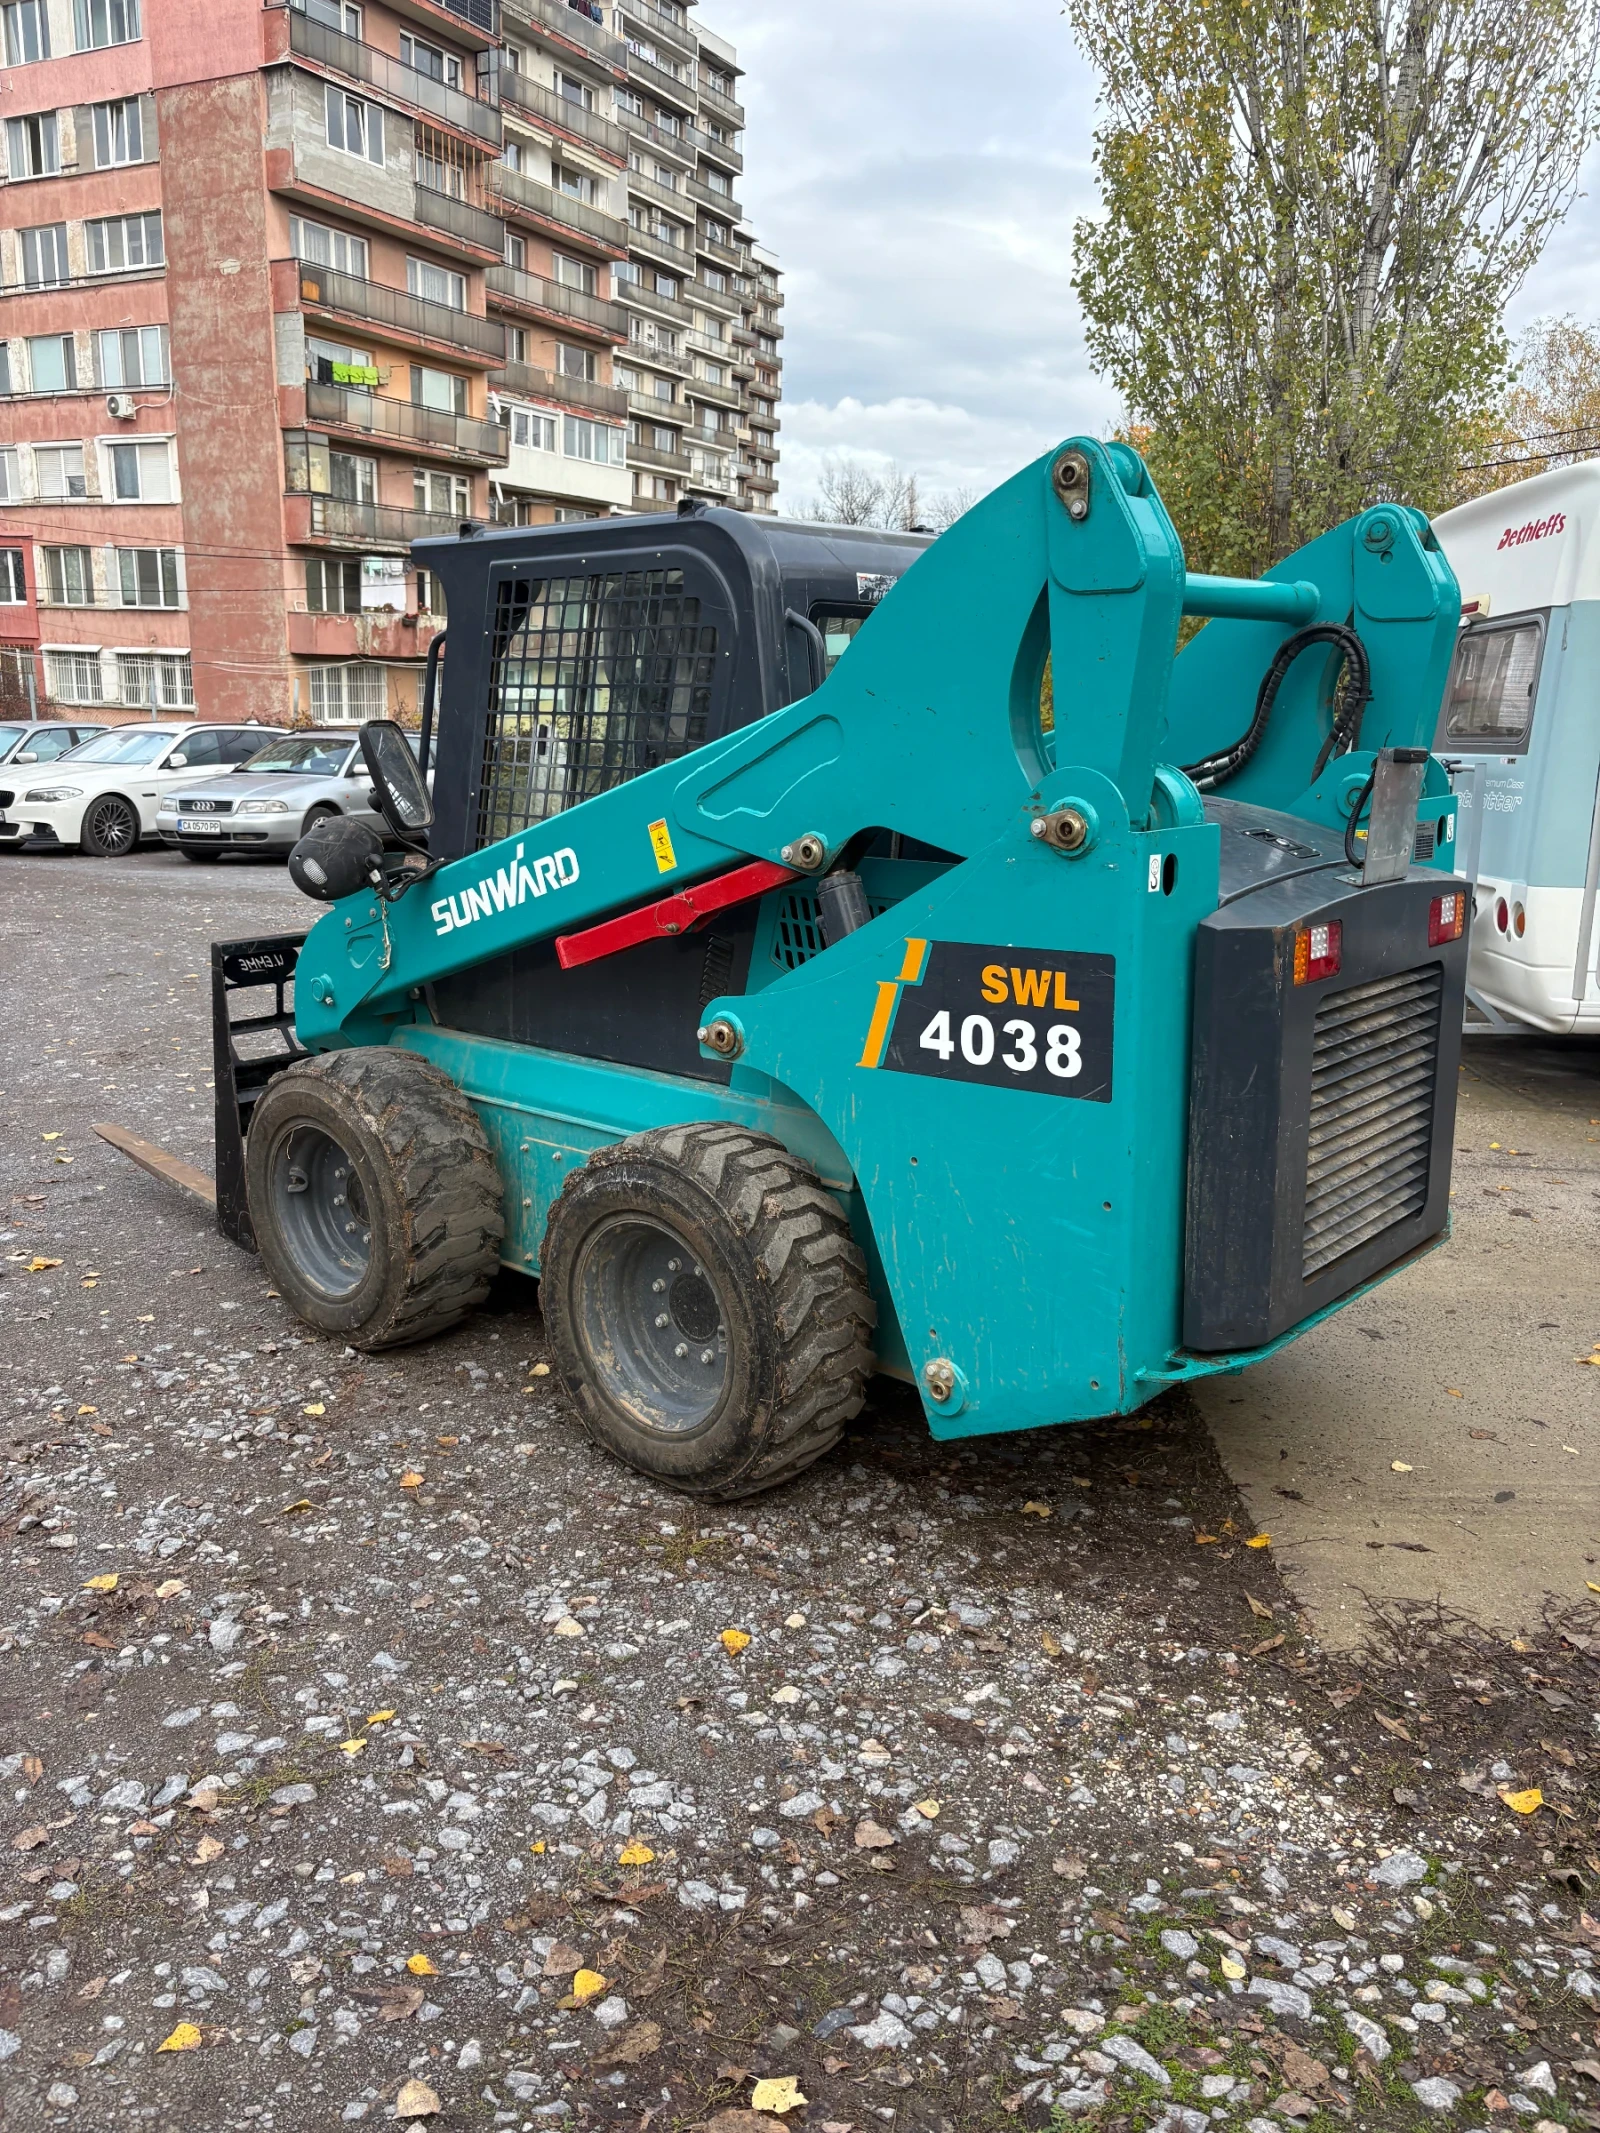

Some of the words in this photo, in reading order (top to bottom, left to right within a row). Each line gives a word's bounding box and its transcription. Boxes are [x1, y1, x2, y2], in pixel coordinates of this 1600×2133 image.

[1497, 513, 1566, 550] Dethleffs
[183, 821, 191, 830] CA
[193, 822, 208, 831] 0570
[210, 822, 219, 831] PP
[431, 842, 580, 936] SUNWARD
[981, 964, 1080, 1011] SWL
[920, 1010, 1082, 1078] 4038
